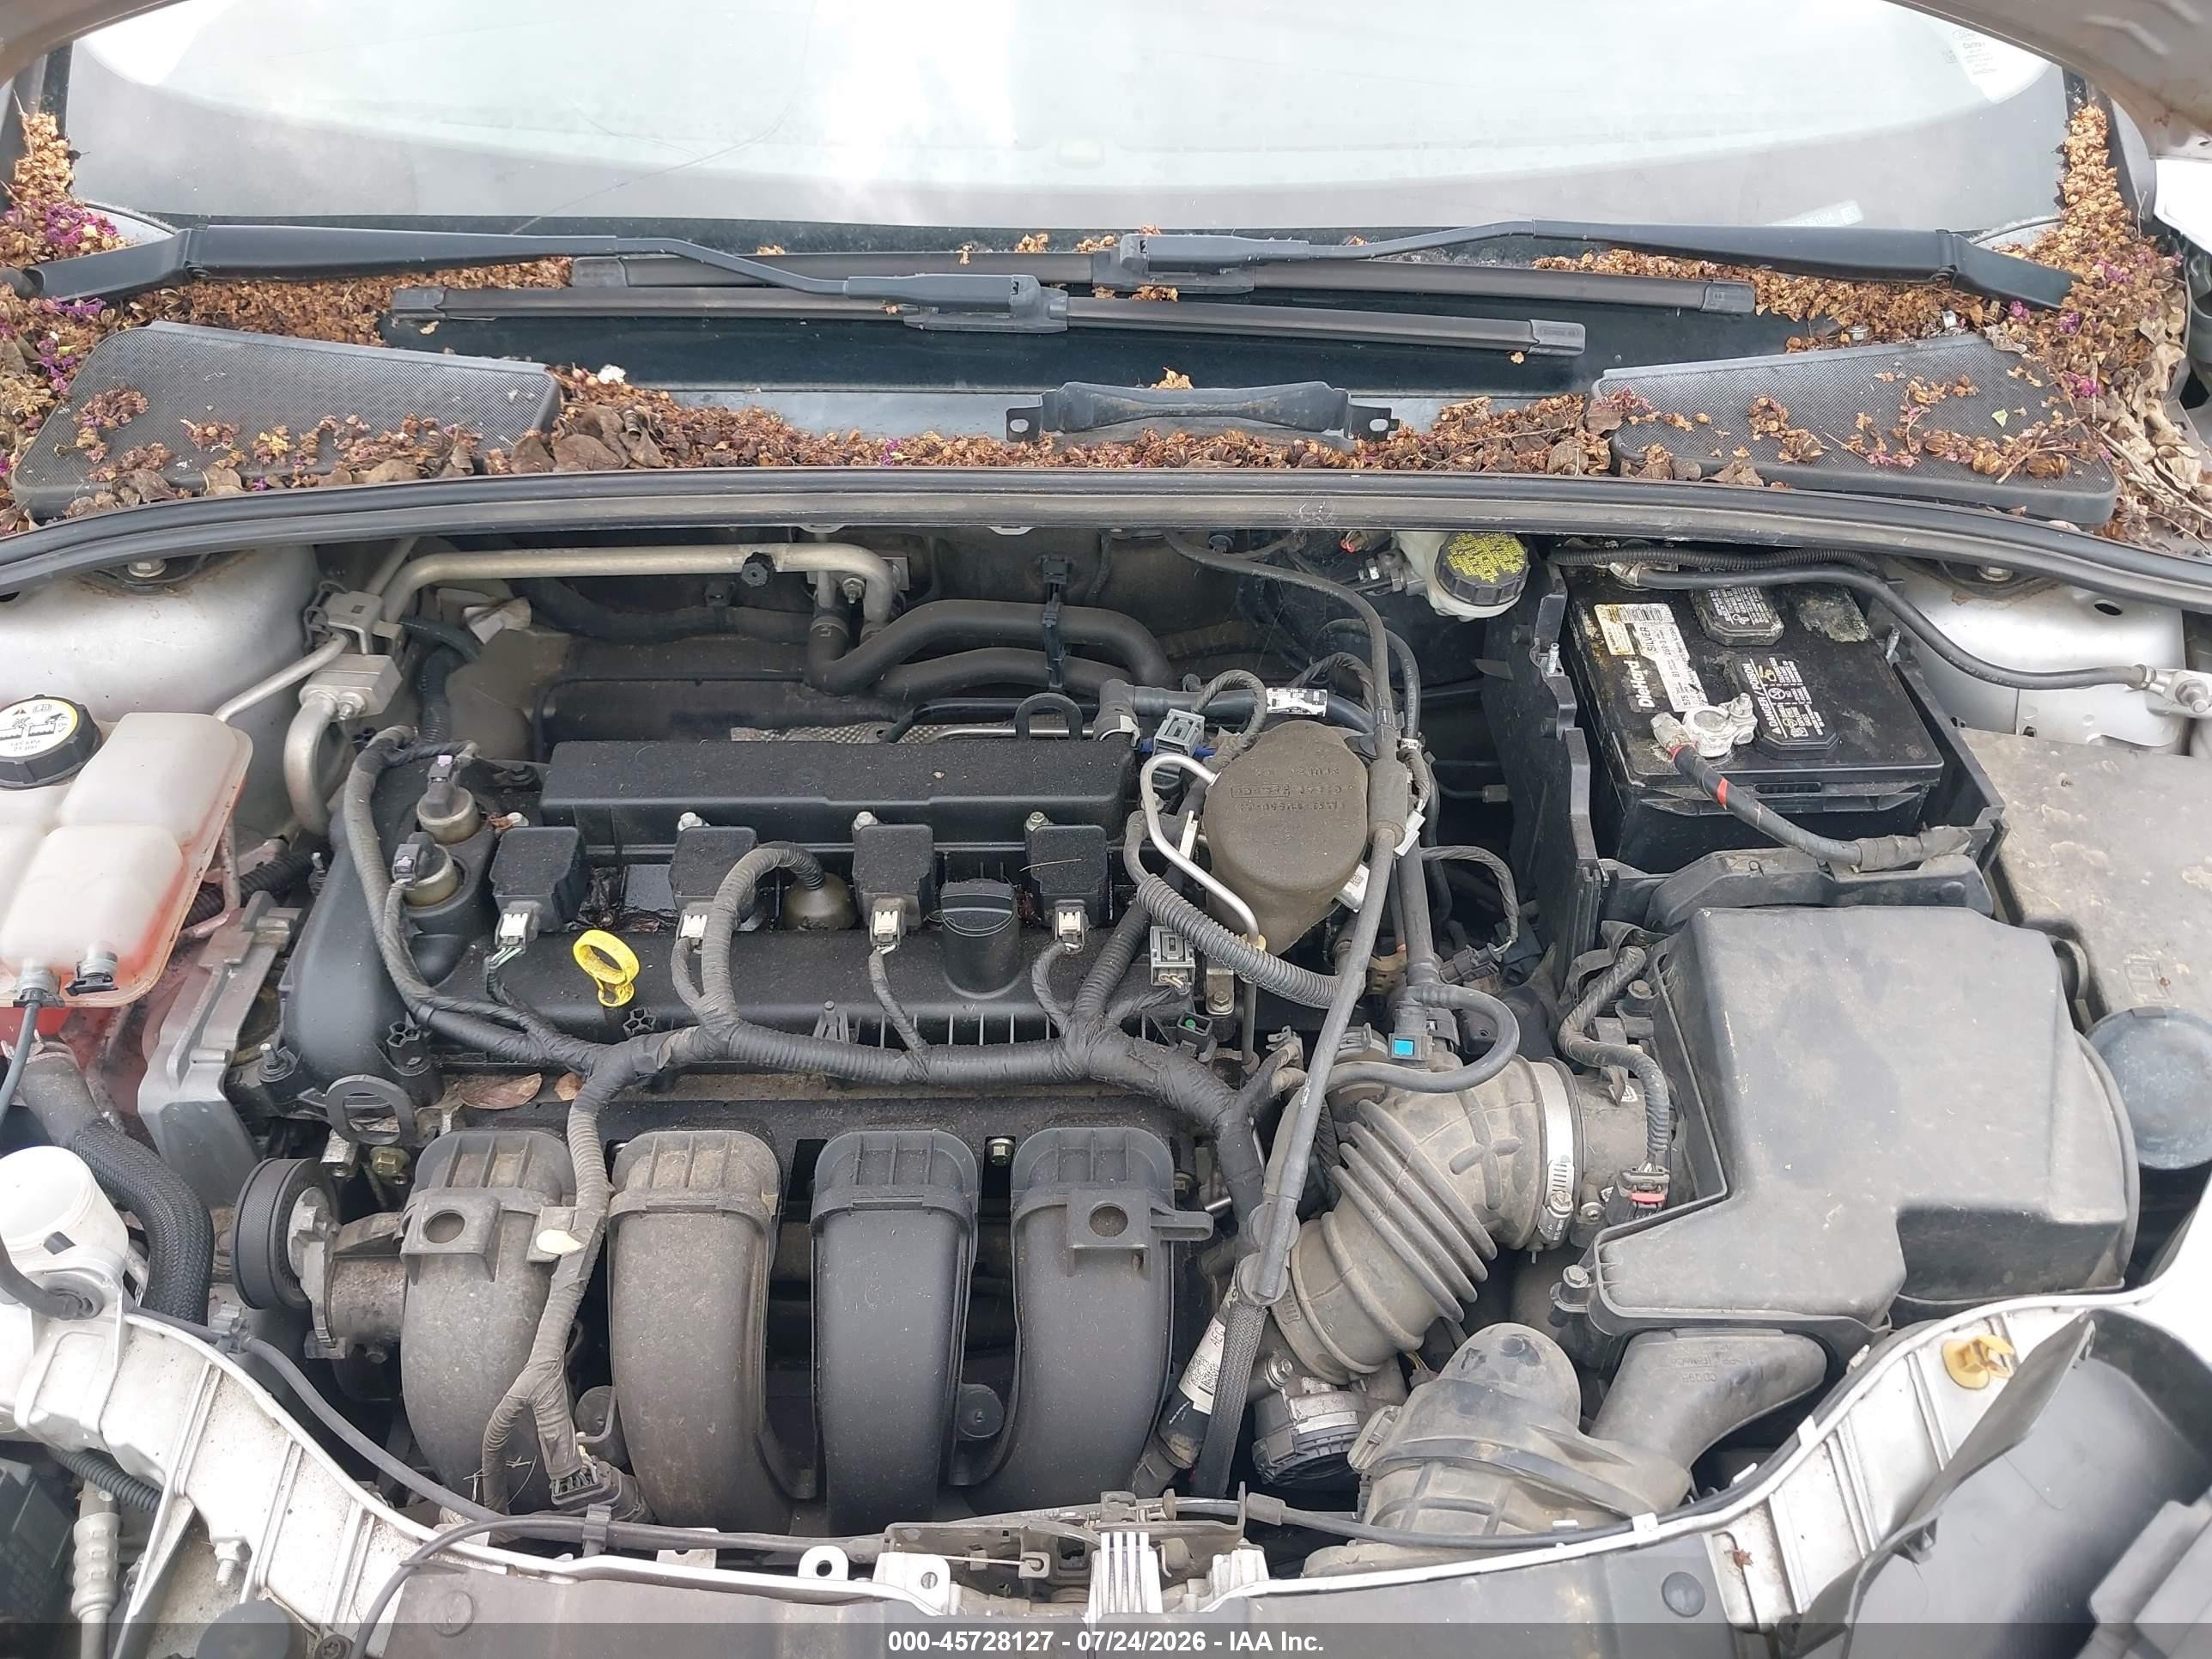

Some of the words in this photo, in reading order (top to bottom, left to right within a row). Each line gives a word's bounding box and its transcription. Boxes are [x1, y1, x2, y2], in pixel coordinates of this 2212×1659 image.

[1640, 626, 1657, 653] SILVER
[1623, 659, 1655, 708] DieHard
[1742, 663, 1762, 690] POISON
[1757, 696, 1780, 727] DANGER
